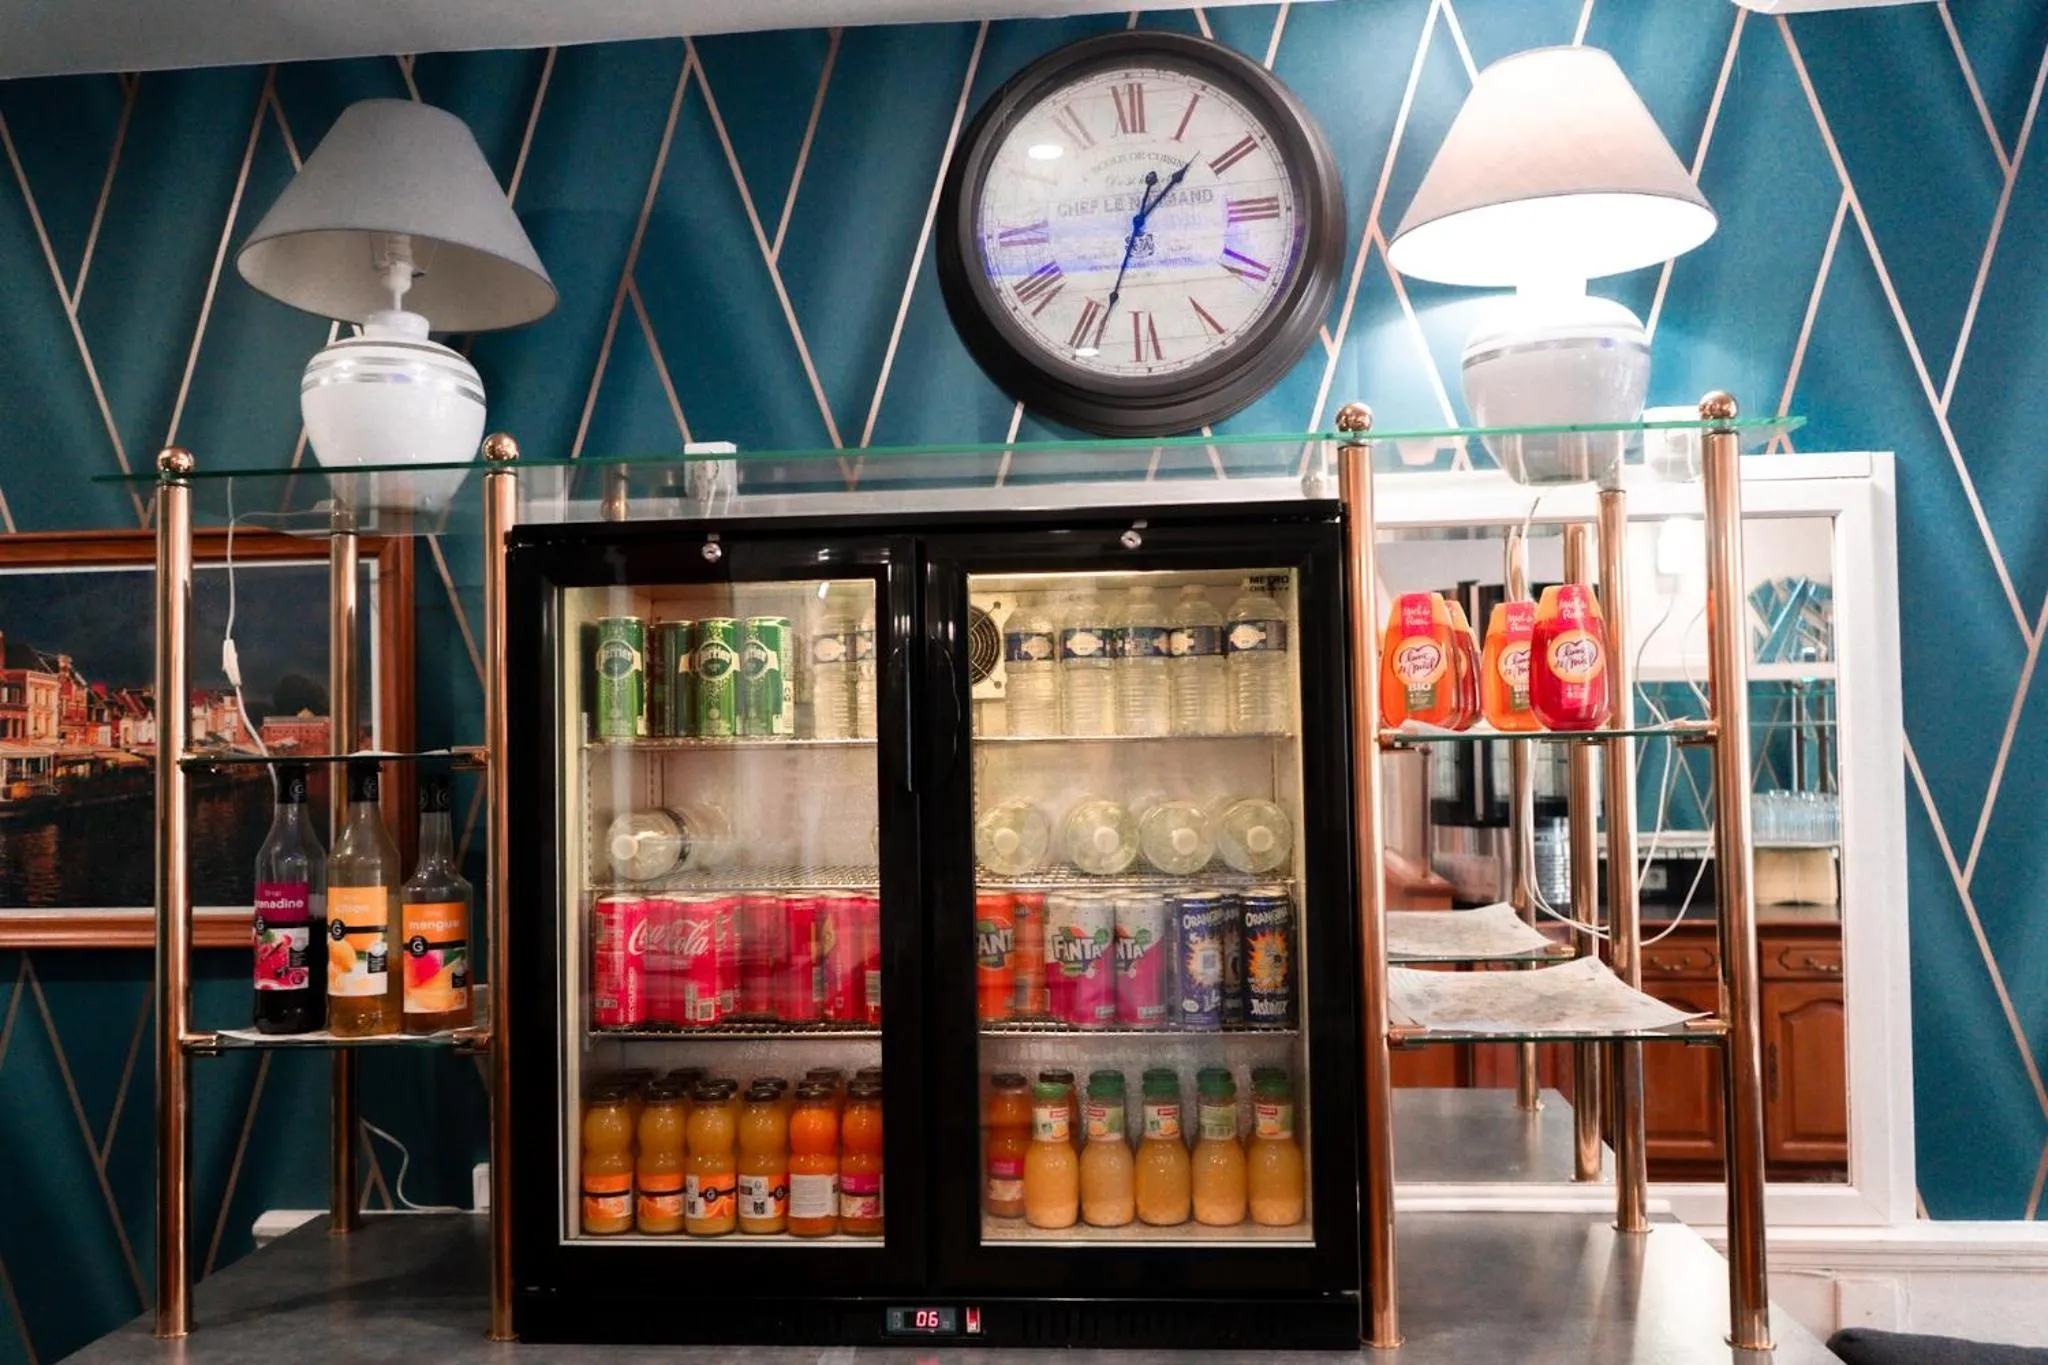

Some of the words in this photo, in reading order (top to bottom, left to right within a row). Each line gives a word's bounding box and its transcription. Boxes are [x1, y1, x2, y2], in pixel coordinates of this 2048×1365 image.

[1057, 198, 1099, 217] CHEF
[1103, 196, 1125, 213] LE
[915, 1310, 939, 1328] 06
